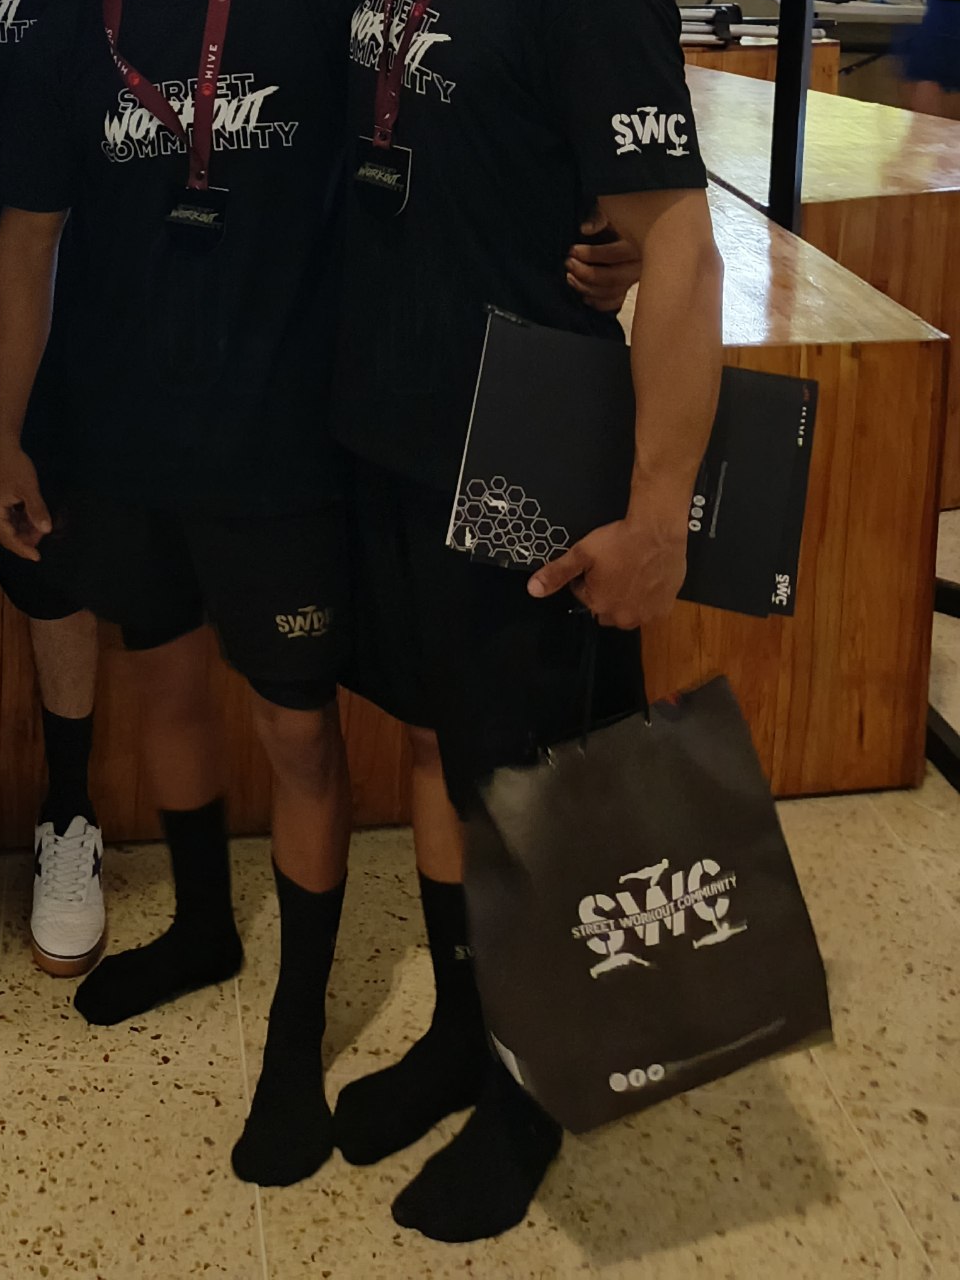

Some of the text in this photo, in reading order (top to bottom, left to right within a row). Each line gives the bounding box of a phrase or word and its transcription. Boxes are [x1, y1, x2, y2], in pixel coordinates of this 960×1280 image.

[204, 44, 218, 79] HIVE
[611, 106, 690, 157] SWC
[771, 573, 790, 607] SWC
[571, 874, 737, 939] STREET WORKOUT COMMUNITY
[577, 858, 742, 975] SWC
